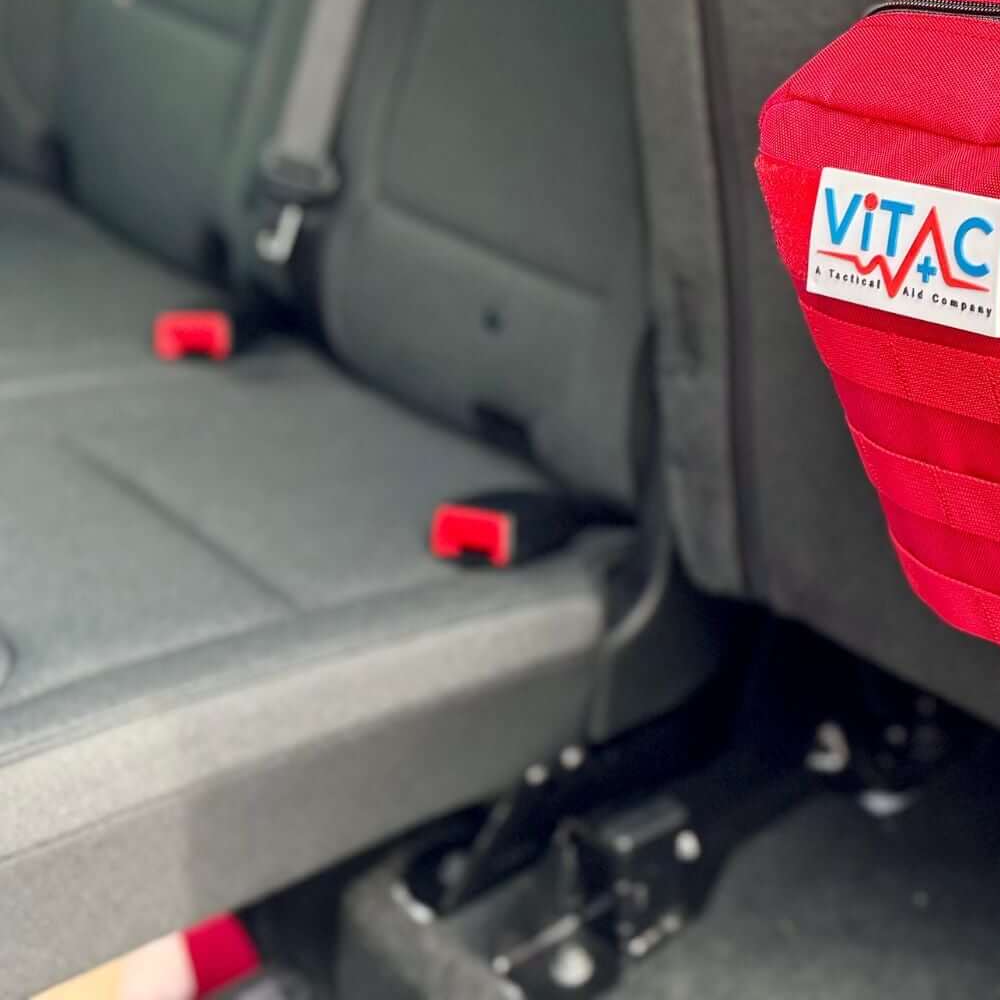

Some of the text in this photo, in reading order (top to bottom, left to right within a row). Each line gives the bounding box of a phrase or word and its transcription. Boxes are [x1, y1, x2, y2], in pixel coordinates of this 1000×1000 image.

[815, 265, 993, 318] A Tactical Aid Company
